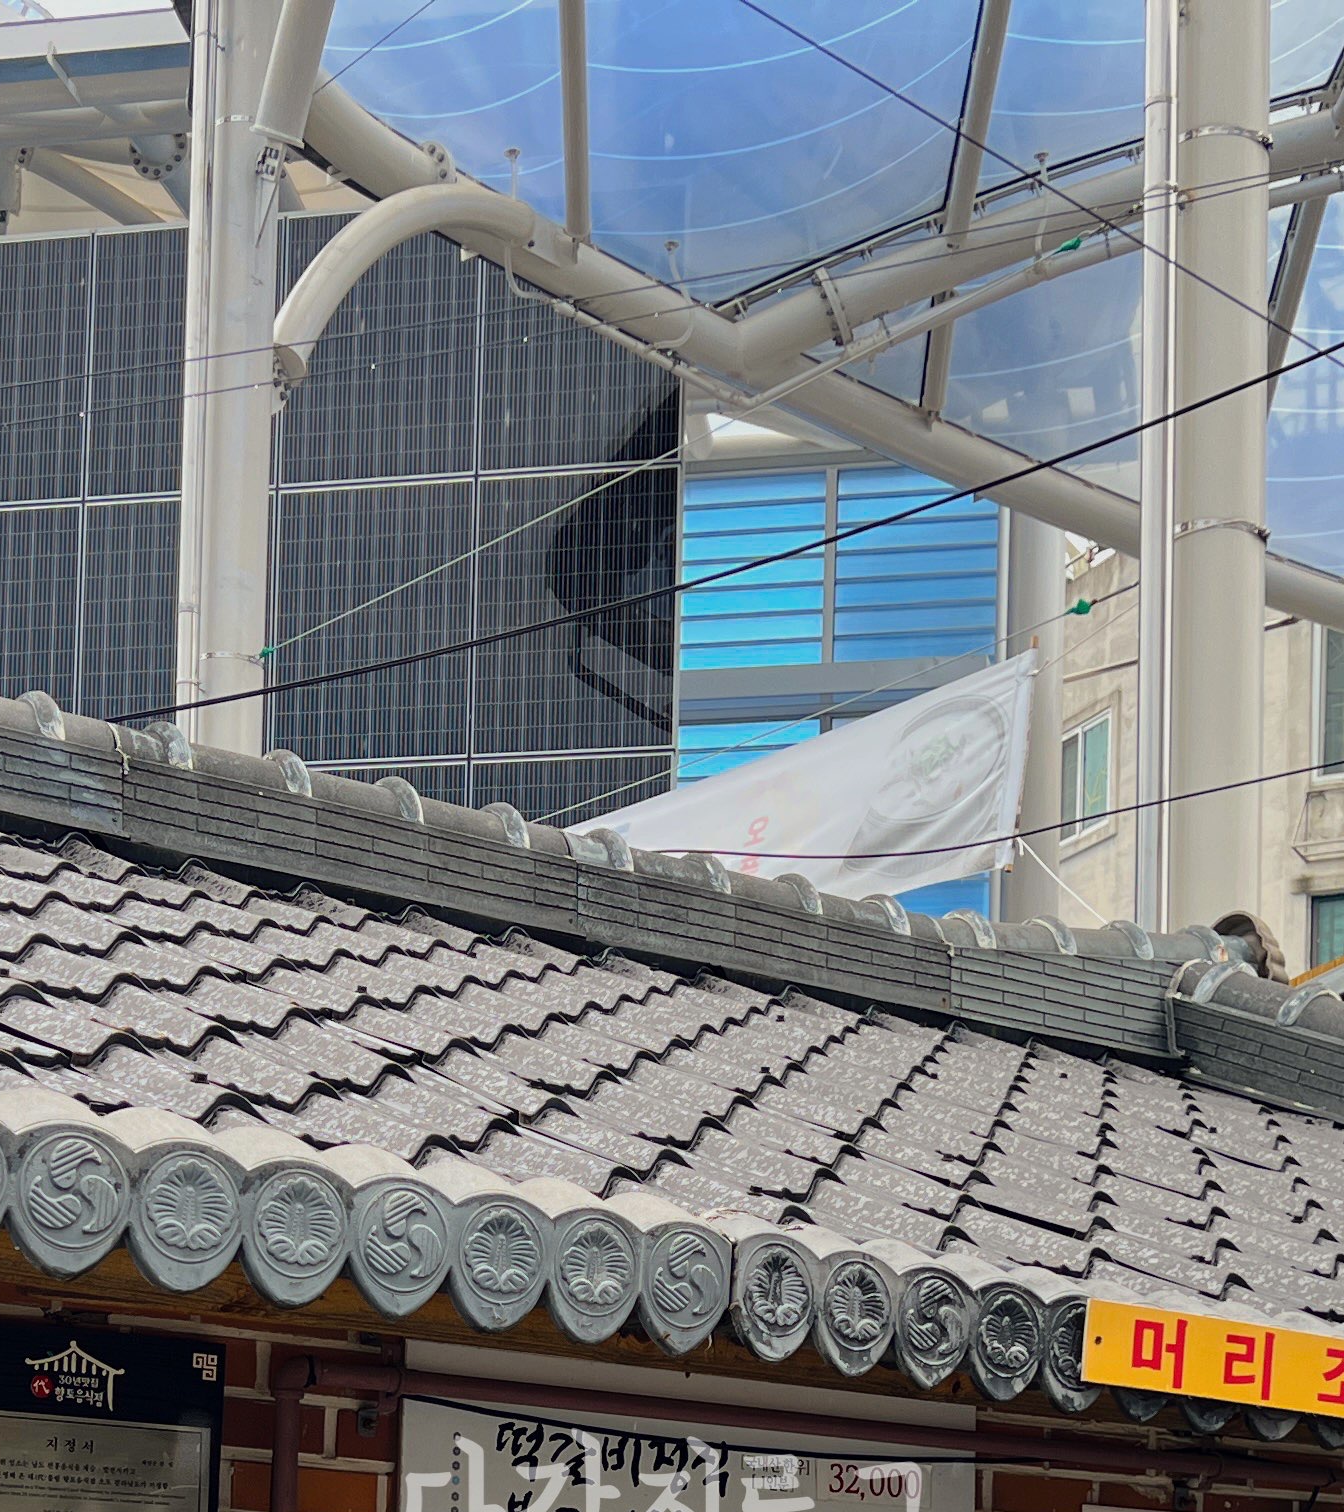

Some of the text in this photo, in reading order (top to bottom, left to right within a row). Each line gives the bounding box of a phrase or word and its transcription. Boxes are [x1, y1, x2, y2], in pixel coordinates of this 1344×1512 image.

[54, 1387, 104, 1408] 향토음식점
[45, 1437, 95, 1454] 지정서
[828, 1462, 921, 1501] 32,000
